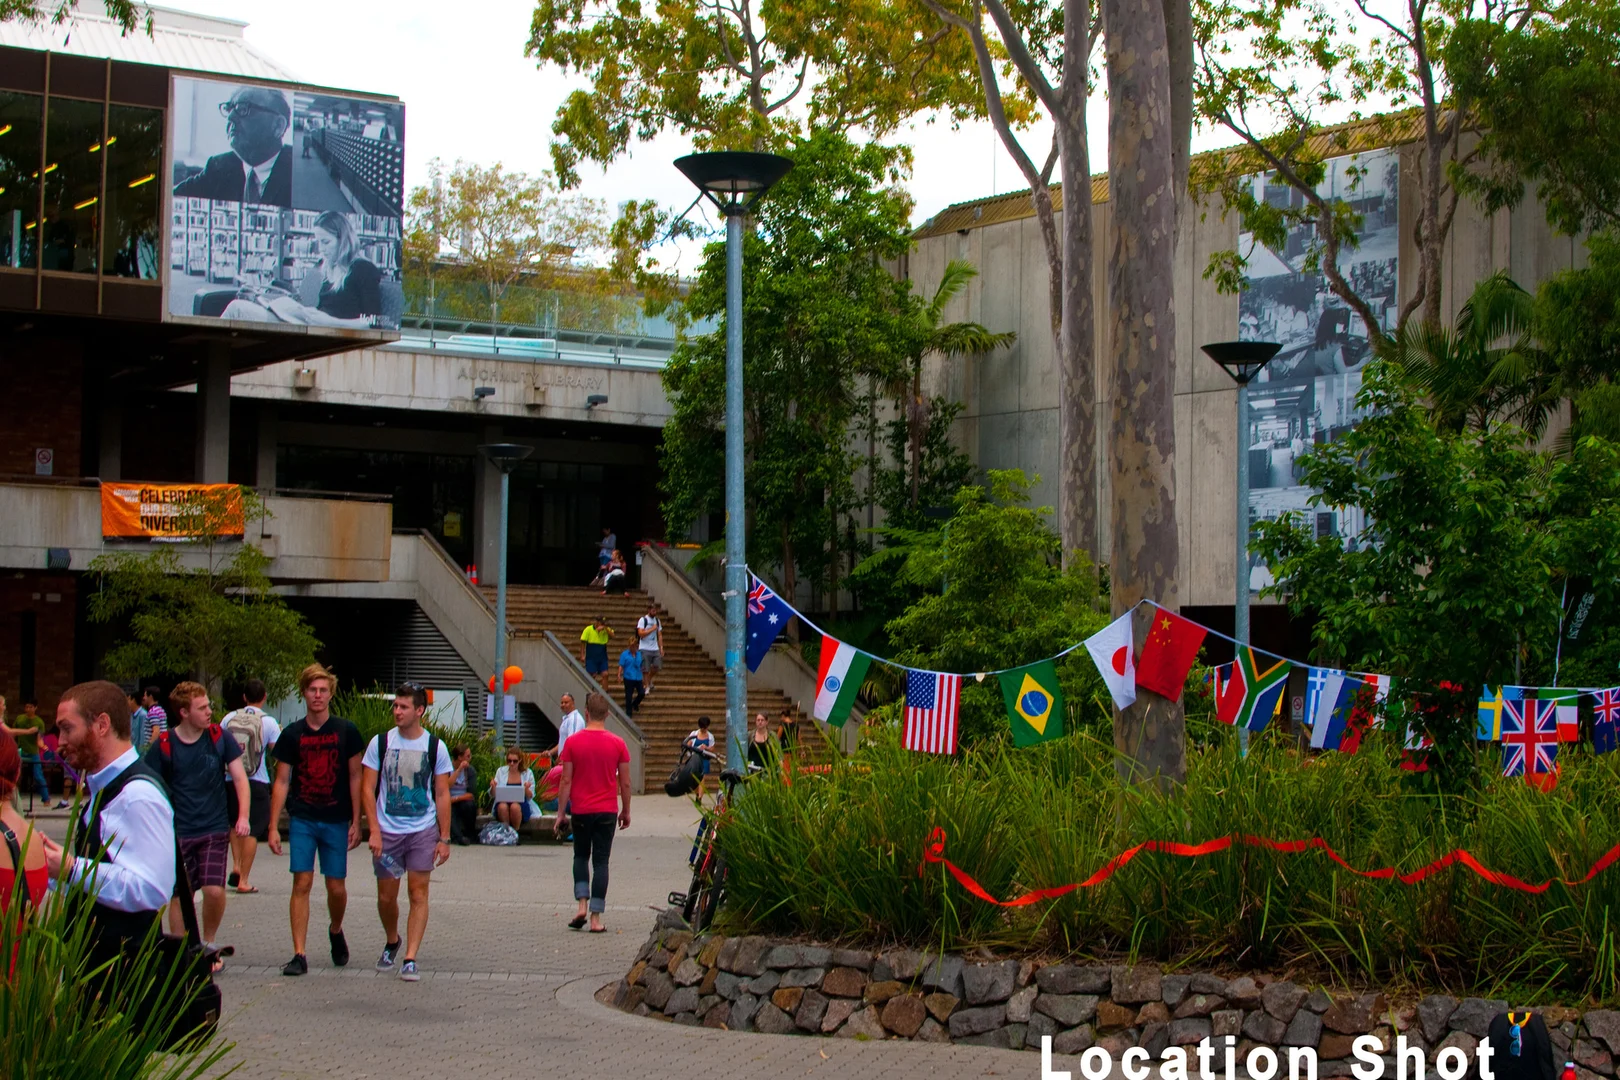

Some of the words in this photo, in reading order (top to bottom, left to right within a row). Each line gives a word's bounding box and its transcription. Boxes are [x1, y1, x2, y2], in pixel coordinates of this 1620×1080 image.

[457, 365, 540, 386] AUCHMUTY
[542, 372, 604, 390] LIBRARY
[140, 503, 159, 516] OUR
